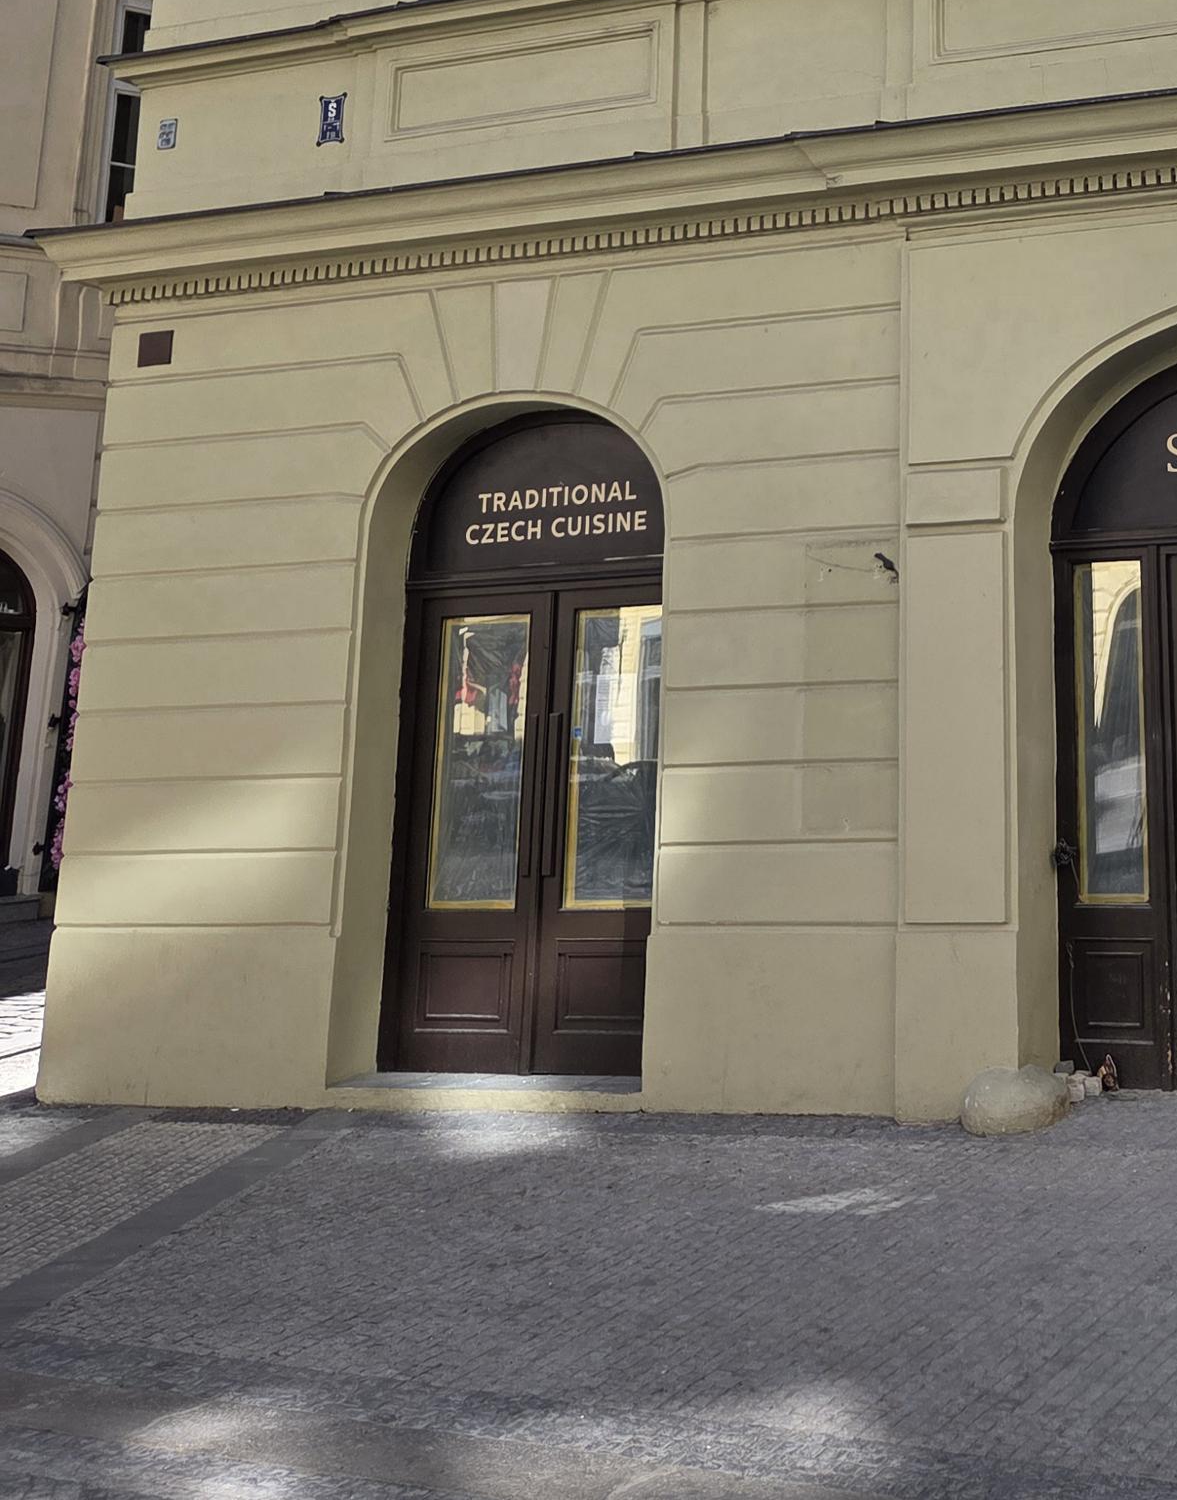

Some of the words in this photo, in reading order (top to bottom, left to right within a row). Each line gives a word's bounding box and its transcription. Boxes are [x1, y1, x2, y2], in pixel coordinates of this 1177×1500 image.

[478, 480, 637, 514] TRADITIONAL
[465, 518, 542, 545] CZECH
[551, 510, 648, 538] CUISINE
